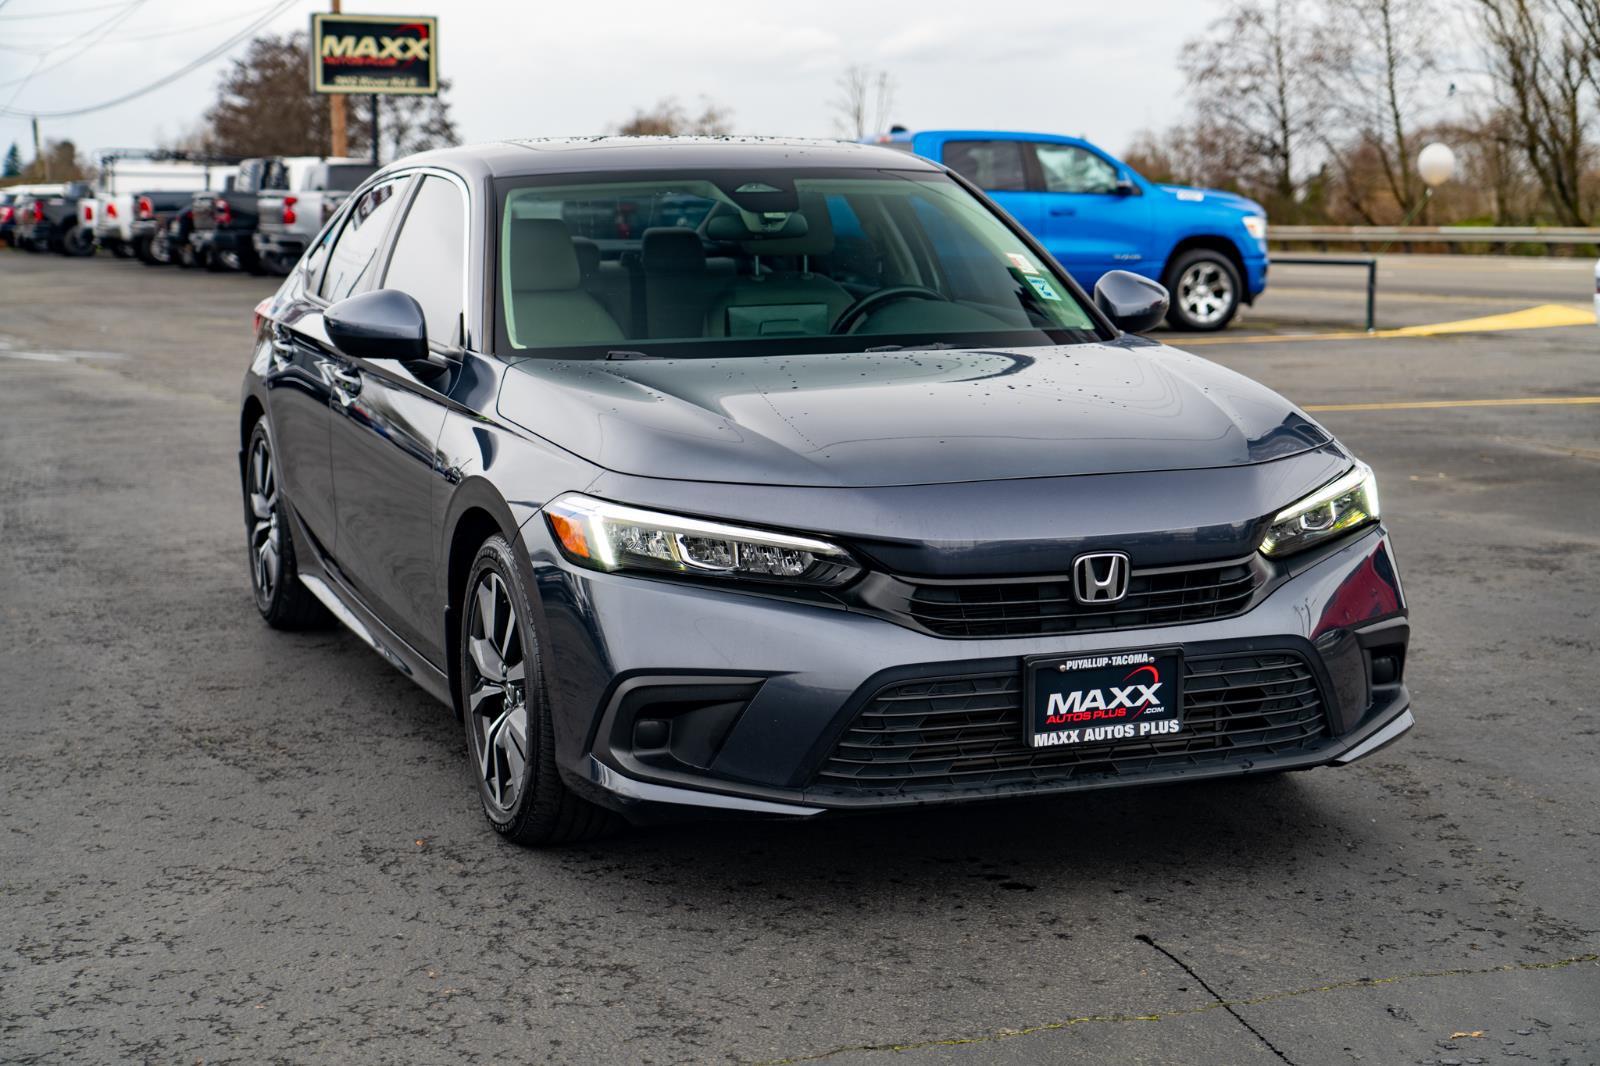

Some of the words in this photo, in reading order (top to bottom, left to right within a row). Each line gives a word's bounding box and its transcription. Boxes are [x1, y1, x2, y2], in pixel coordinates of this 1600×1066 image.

[321, 35, 429, 60] MAXX
[1046, 682, 1163, 716] MAXX
[1046, 713, 1091, 725] AUTOS
[1092, 707, 1127, 720] PLUS
[1034, 731, 1081, 748] MAXX
[1084, 723, 1135, 742] AUTOS
[1139, 719, 1180, 736] PLUS
